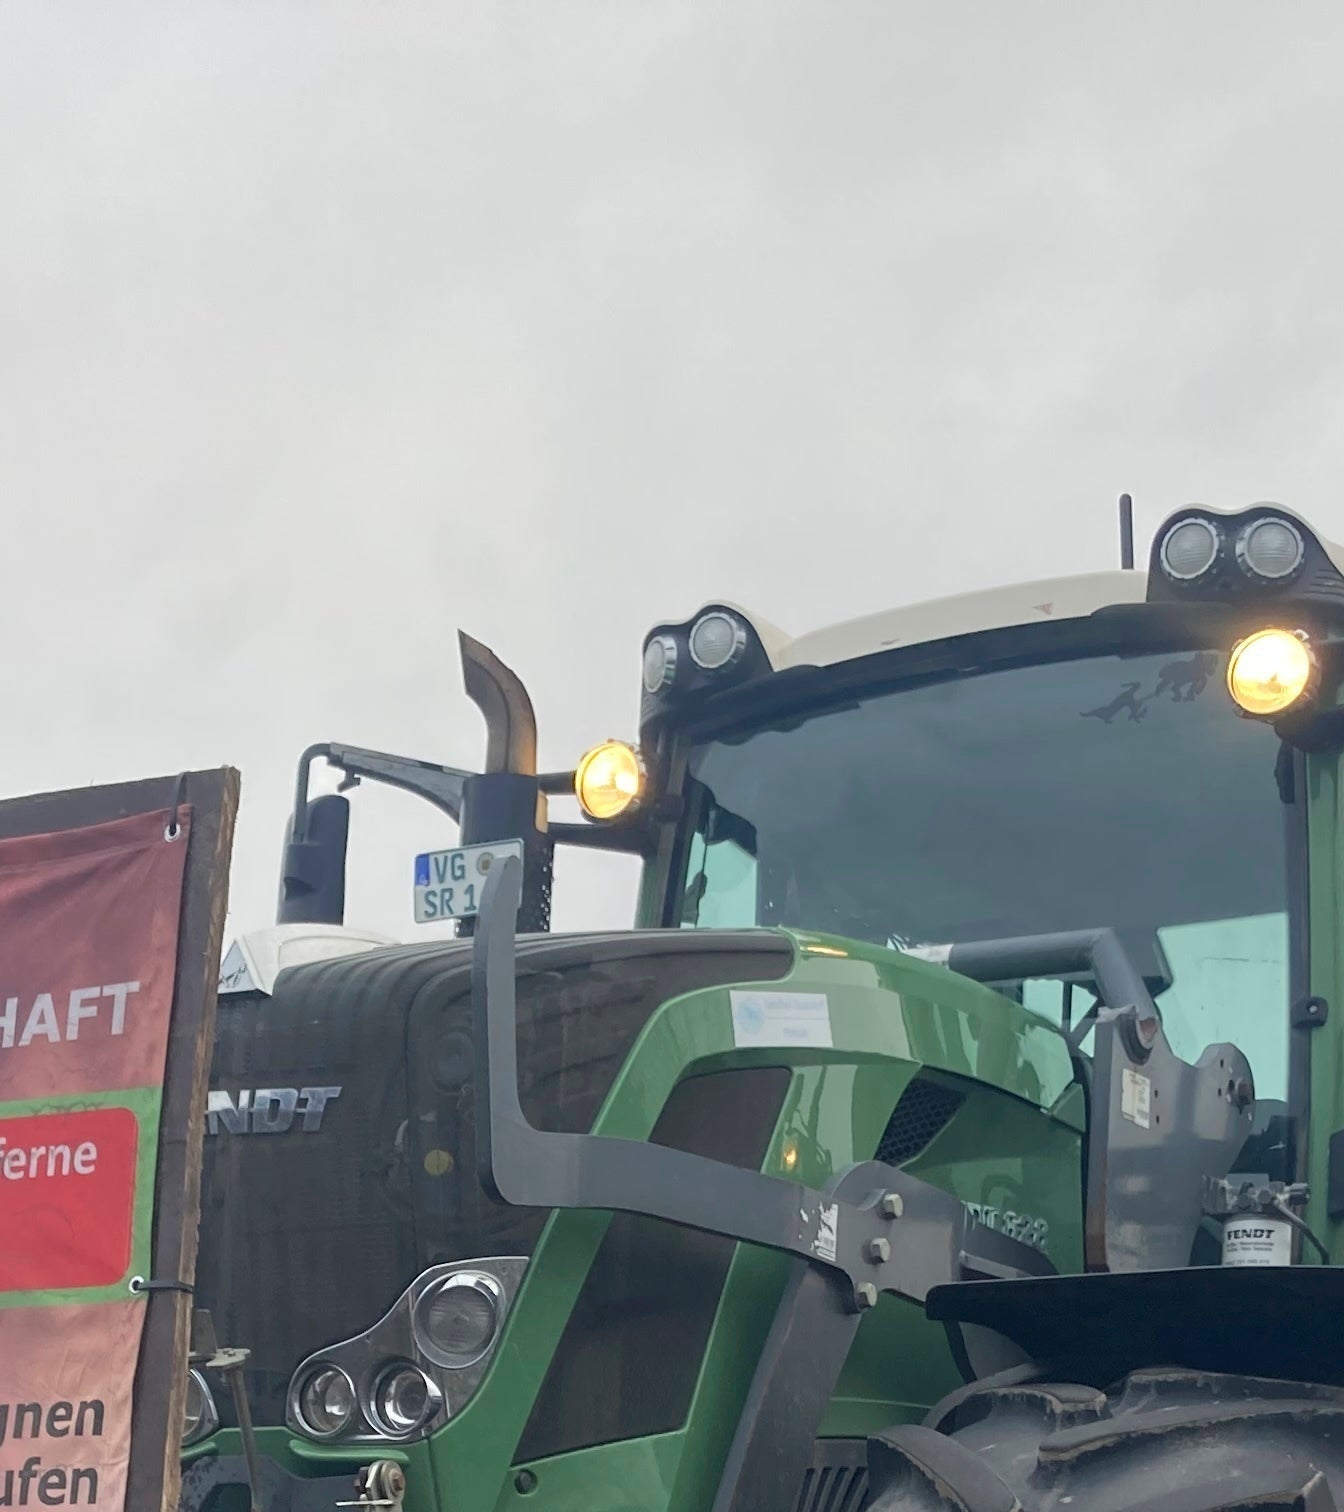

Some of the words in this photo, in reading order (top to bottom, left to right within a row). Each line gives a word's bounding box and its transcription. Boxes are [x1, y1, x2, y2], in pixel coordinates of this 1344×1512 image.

[434, 853, 466, 883] VG
[424, 887, 454, 918] SR
[464, 884, 477, 911] 1
[205, 1086, 344, 1135] NDT
[1227, 1228, 1276, 1240] FENDT
